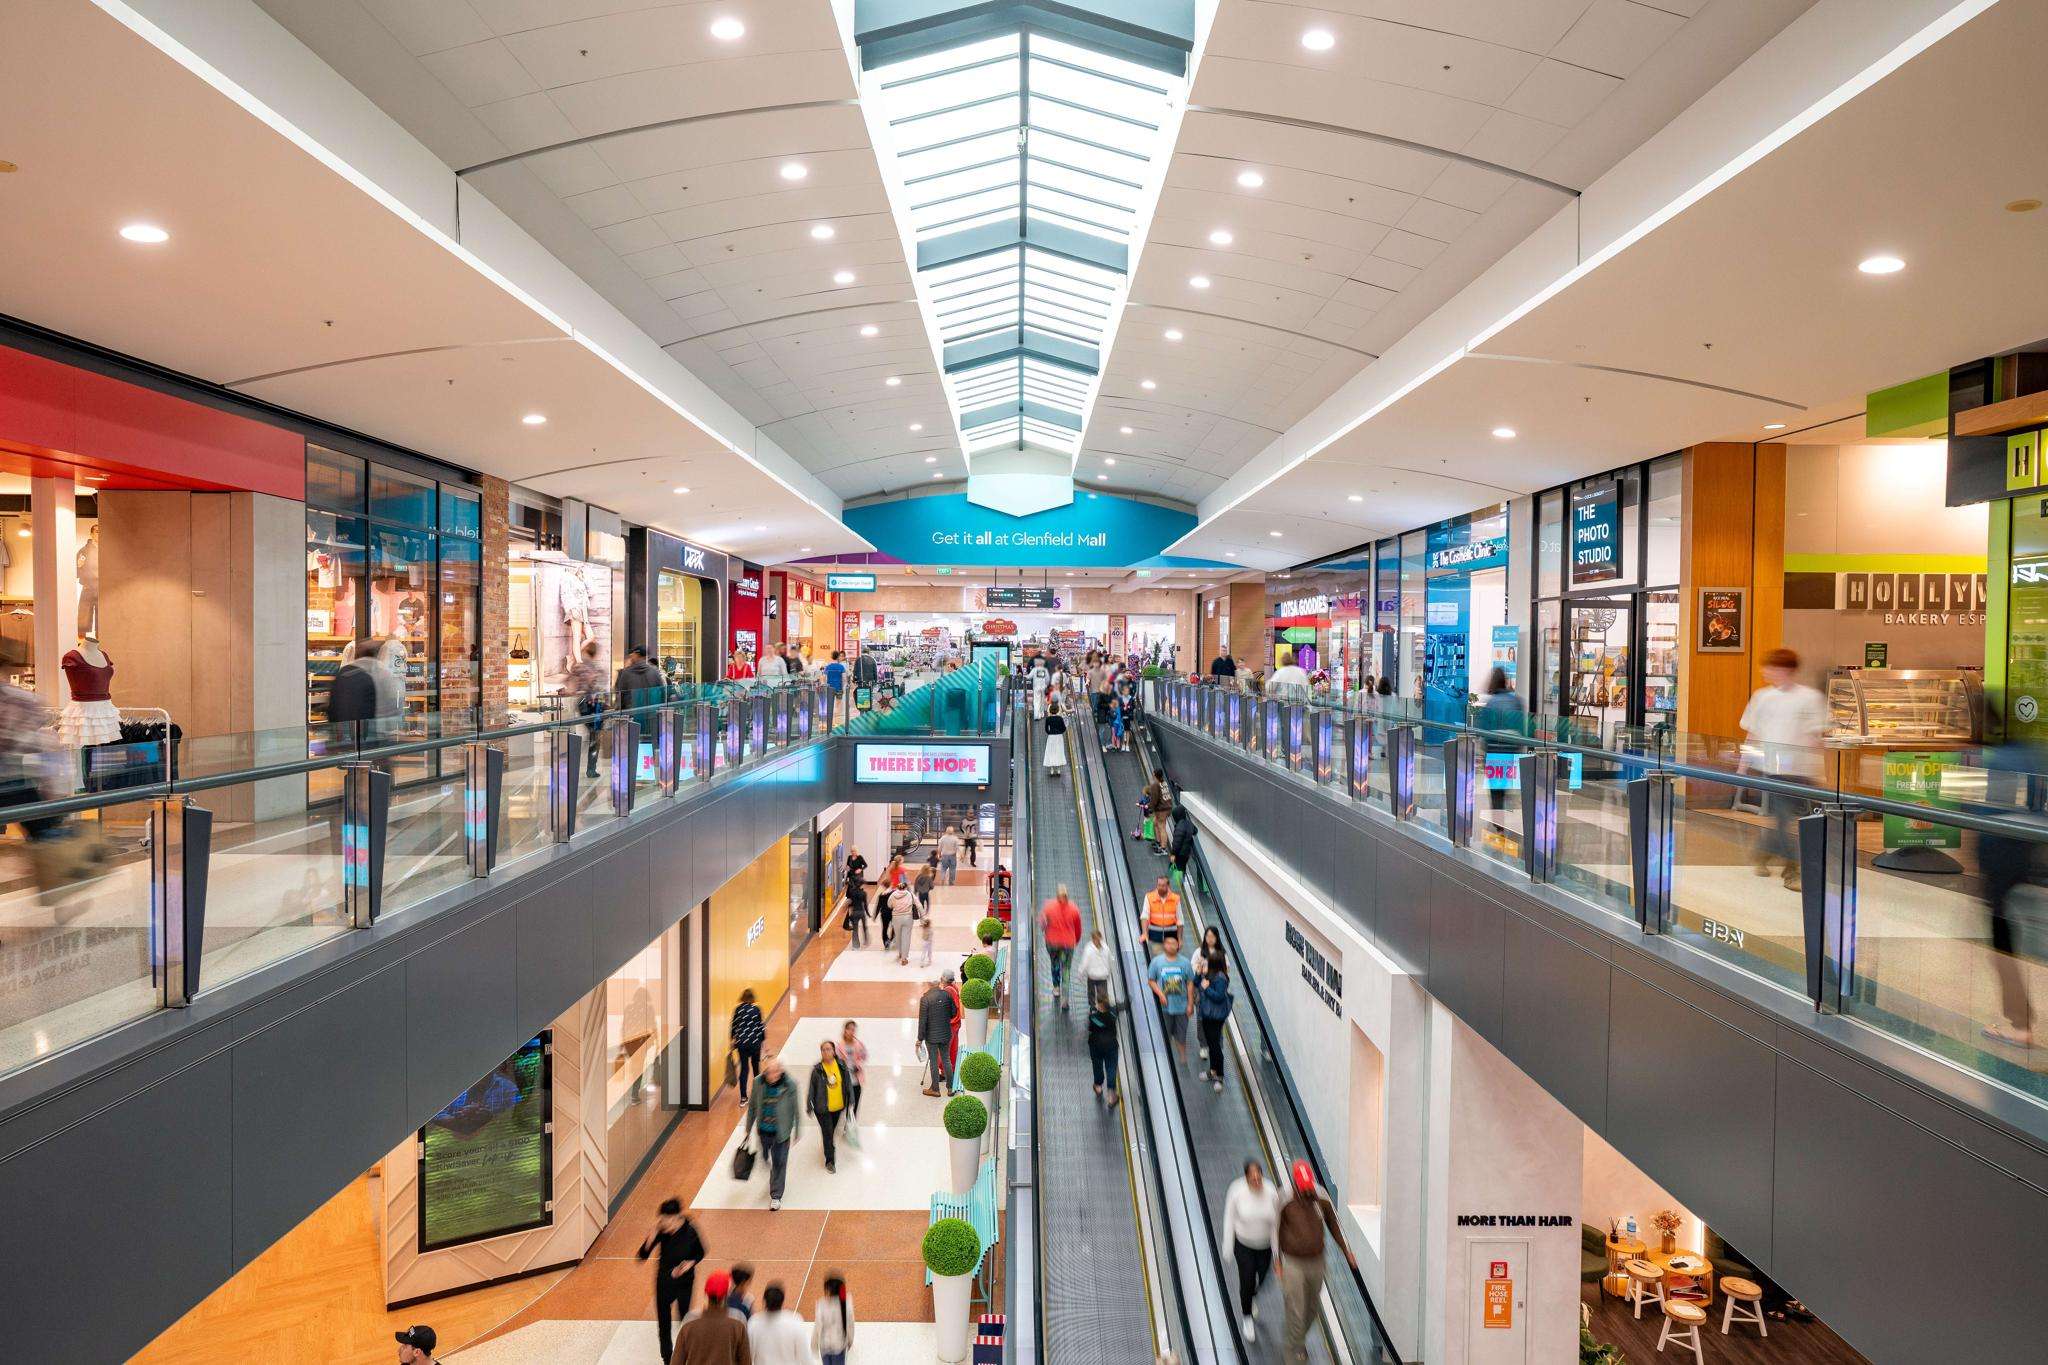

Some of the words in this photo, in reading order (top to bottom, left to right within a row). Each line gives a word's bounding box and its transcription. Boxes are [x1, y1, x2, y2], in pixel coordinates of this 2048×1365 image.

[1578, 503, 1596, 521] THE
[932, 531, 959, 545] Get
[963, 531, 973, 545] it
[975, 531, 992, 545] all
[995, 534, 1009, 546] at
[1012, 532, 1073, 546] Glenfield
[1078, 533, 1106, 546] Mall
[1578, 522, 1610, 543] PHOTO
[1440, 551, 1449, 566] The
[1578, 545, 1612, 565] STUDIO
[1281, 599, 1299, 617] LOTSA
[1300, 594, 1328, 616] GOODIES
[1884, 613, 1950, 625] BAKERY
[1959, 614, 1987, 625] ESP
[984, 623, 1016, 631] CHRISTMAS
[868, 757, 914, 772] THERE
[917, 757, 931, 772] IS
[933, 758, 977, 773] HOPE
[1887, 762, 1919, 776] NOW
[437, 1150, 461, 1160] Score
[1457, 1214, 1497, 1226] MORE
[1499, 1215, 1536, 1227] THAN
[1538, 1215, 1573, 1227] HAIR
